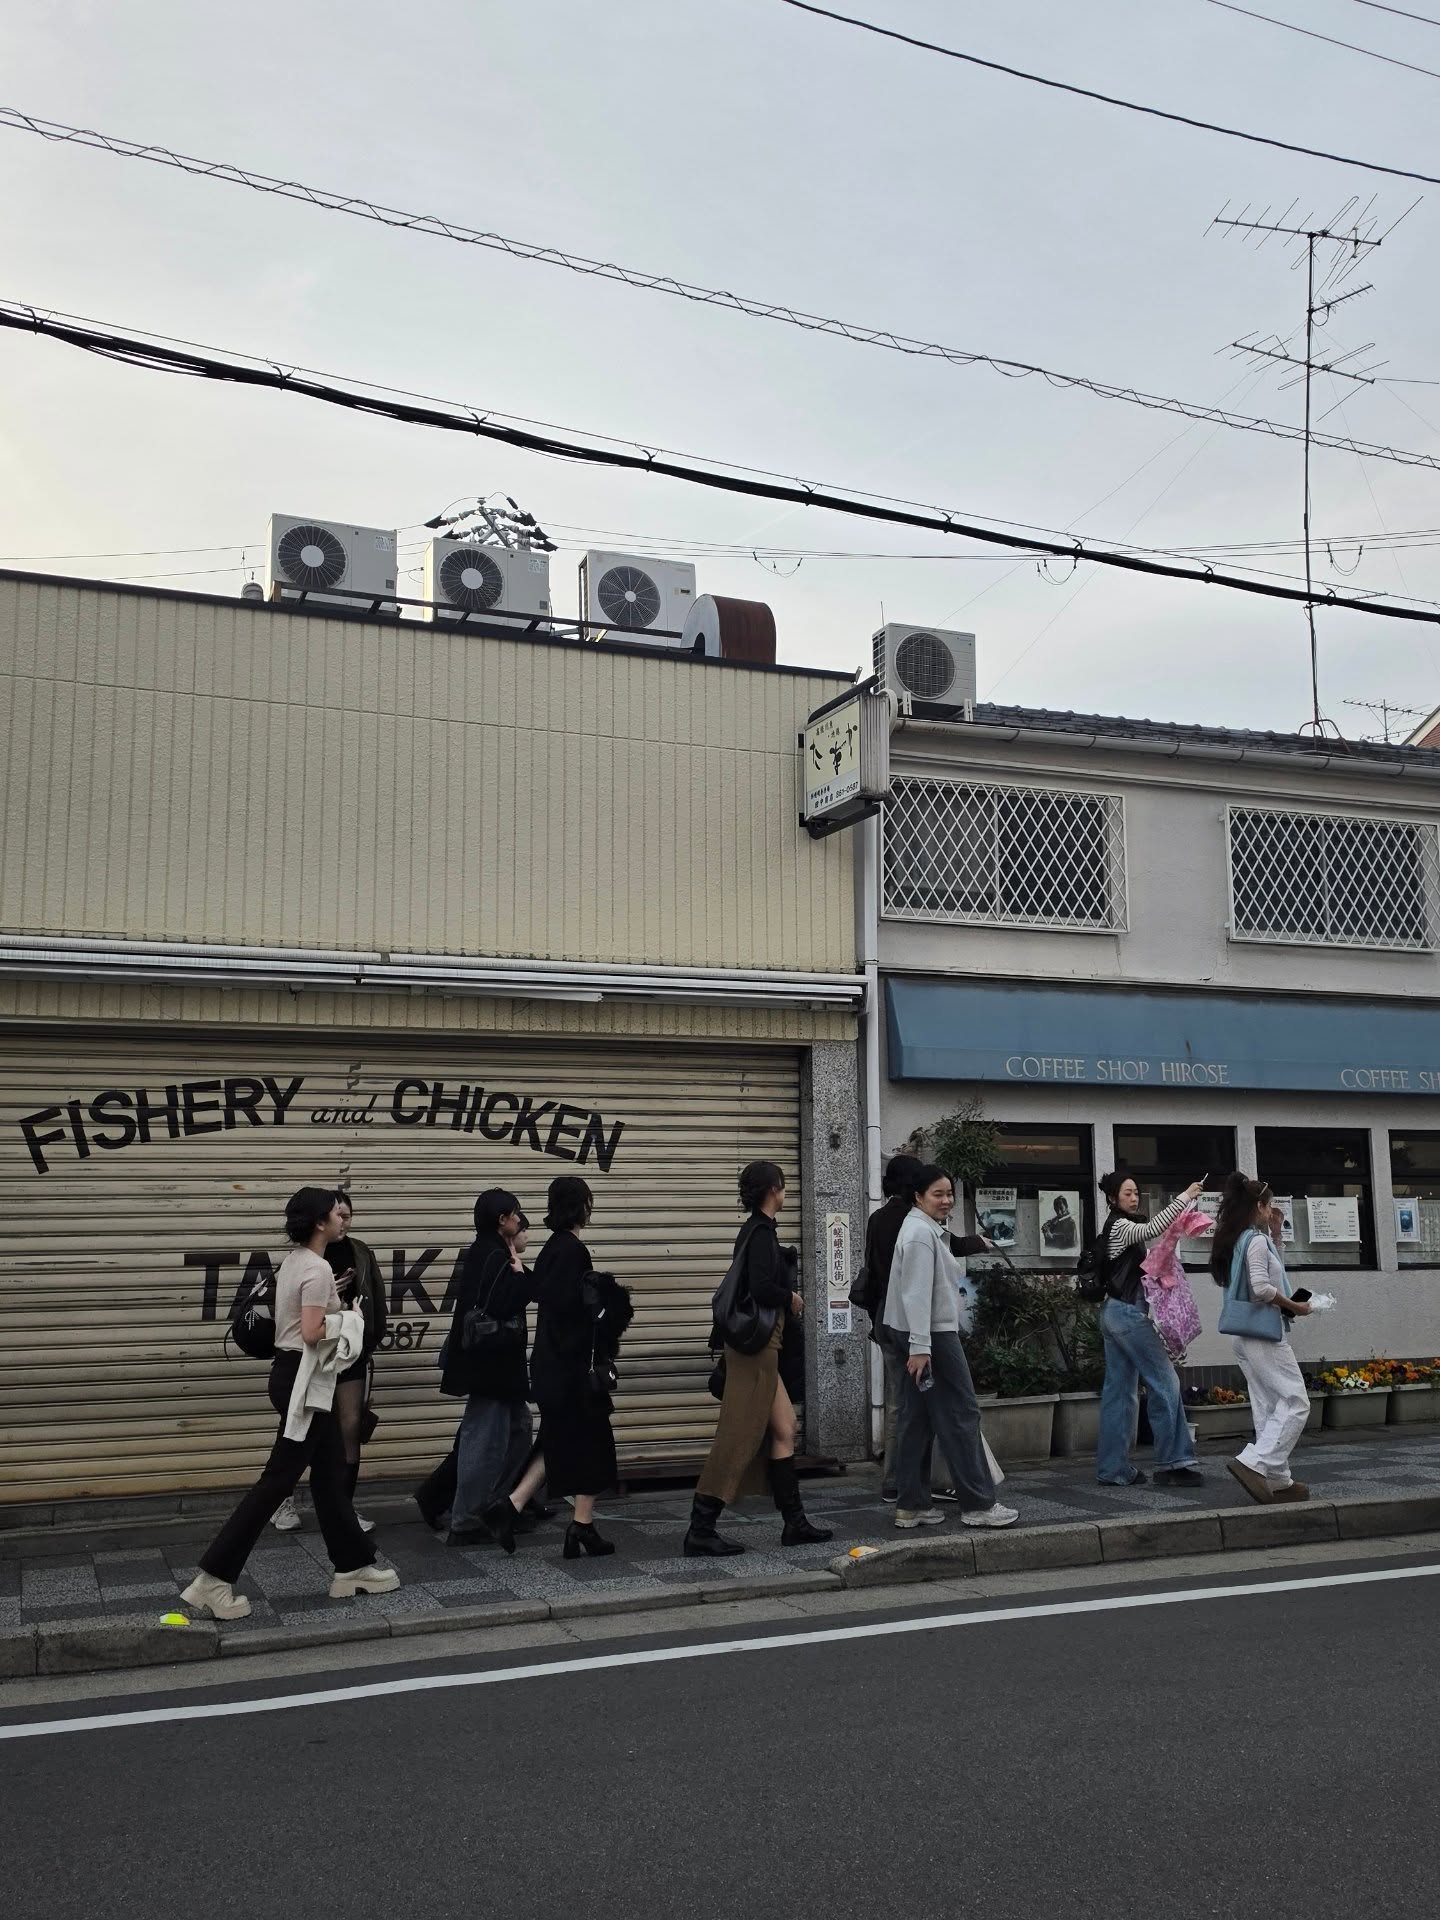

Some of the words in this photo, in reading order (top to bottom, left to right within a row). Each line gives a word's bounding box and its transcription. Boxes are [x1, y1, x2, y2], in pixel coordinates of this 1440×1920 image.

[1005, 1055, 1086, 1080] COFFEE
[1096, 1060, 1151, 1082] SHOP
[1161, 1061, 1230, 1086] HIROSE
[1340, 1068, 1410, 1090] COFFEE
[18, 1076, 304, 1175] FISHERY
[310, 1093, 376, 1125] and
[391, 1078, 625, 1173] CHICKEN
[833, 1226, 845, 1282] 嵯峨商店街
